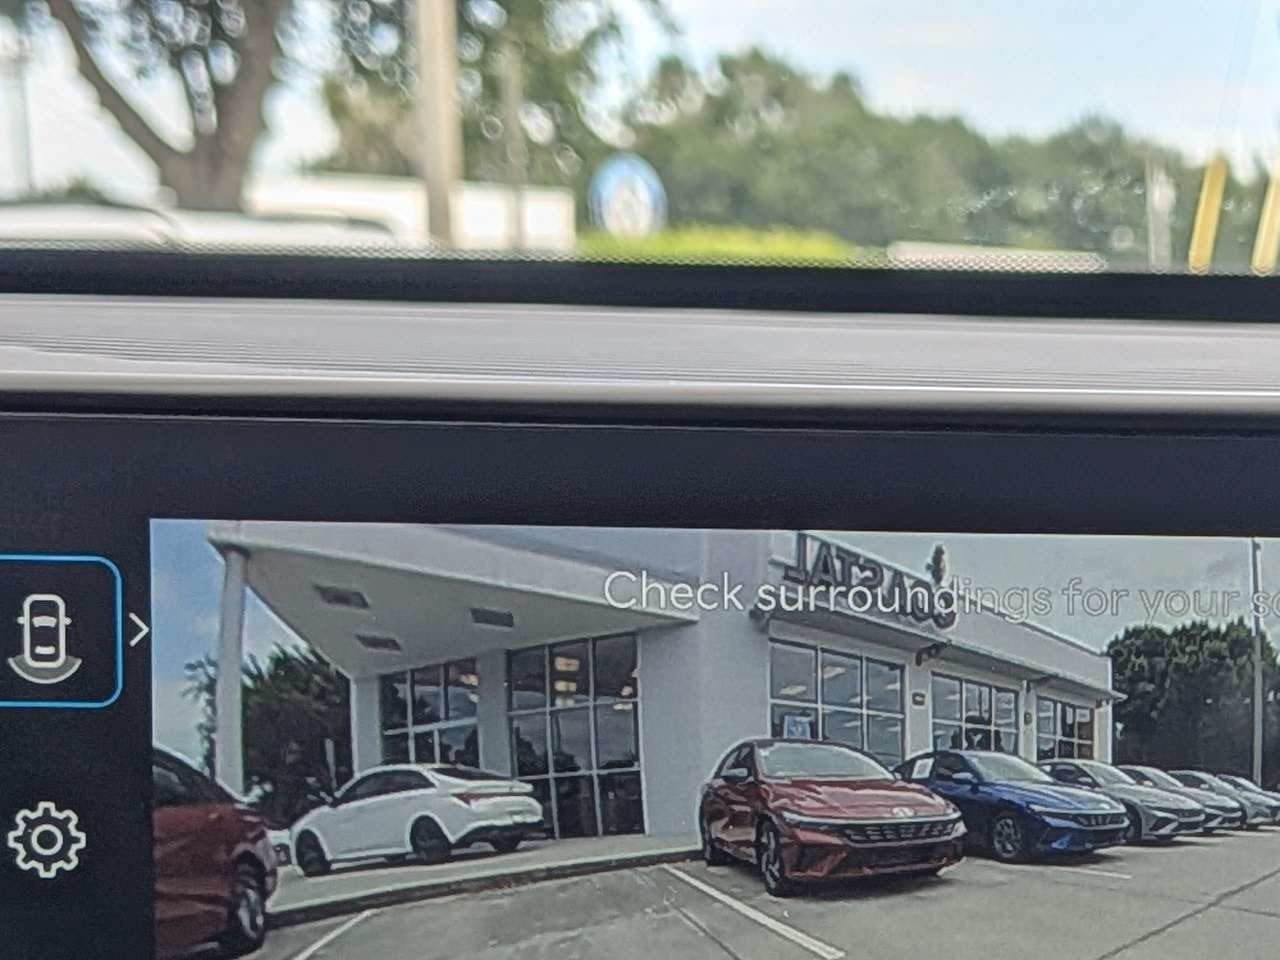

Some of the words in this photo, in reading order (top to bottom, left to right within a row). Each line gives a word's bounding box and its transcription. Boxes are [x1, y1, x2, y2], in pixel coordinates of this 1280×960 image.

[603, 570, 744, 611] Check
[756, 574, 1050, 623] surroundings
[1060, 576, 1129, 617] for
[1137, 588, 1239, 627] your
